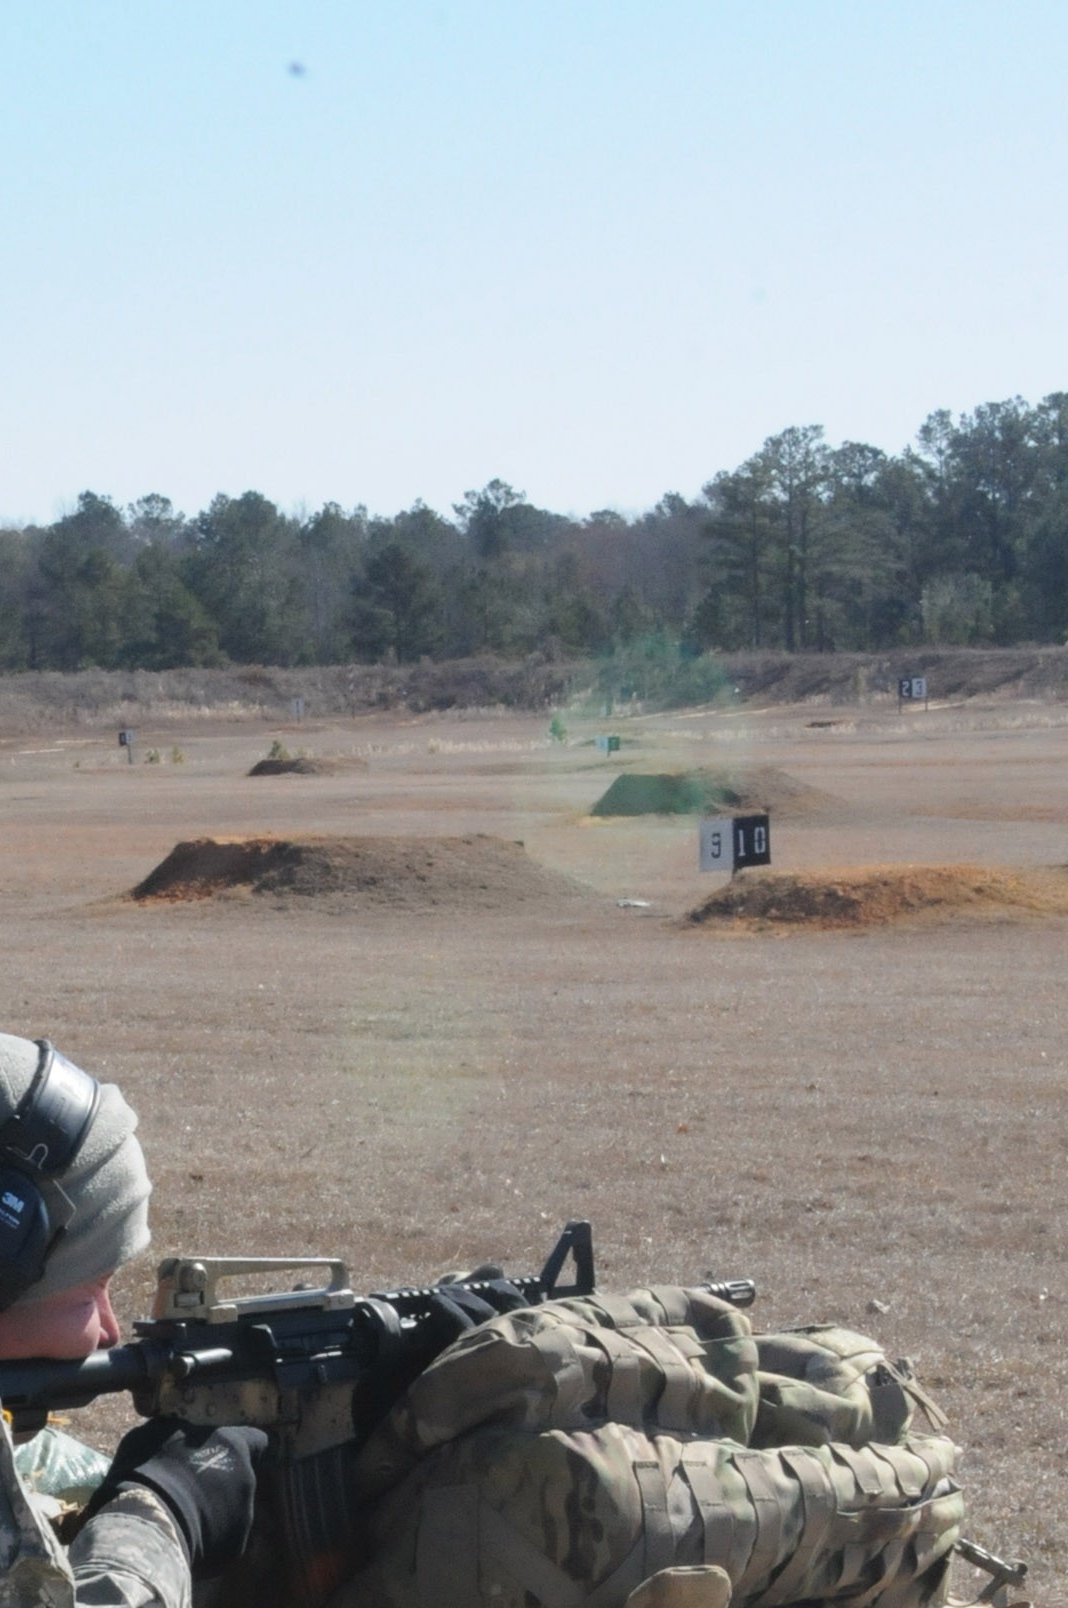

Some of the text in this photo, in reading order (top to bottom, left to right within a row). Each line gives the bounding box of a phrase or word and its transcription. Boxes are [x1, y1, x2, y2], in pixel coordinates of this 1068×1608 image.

[711, 832, 722, 859] 9
[738, 826, 766, 857] 10
[2, 1191, 25, 1214] 3M
